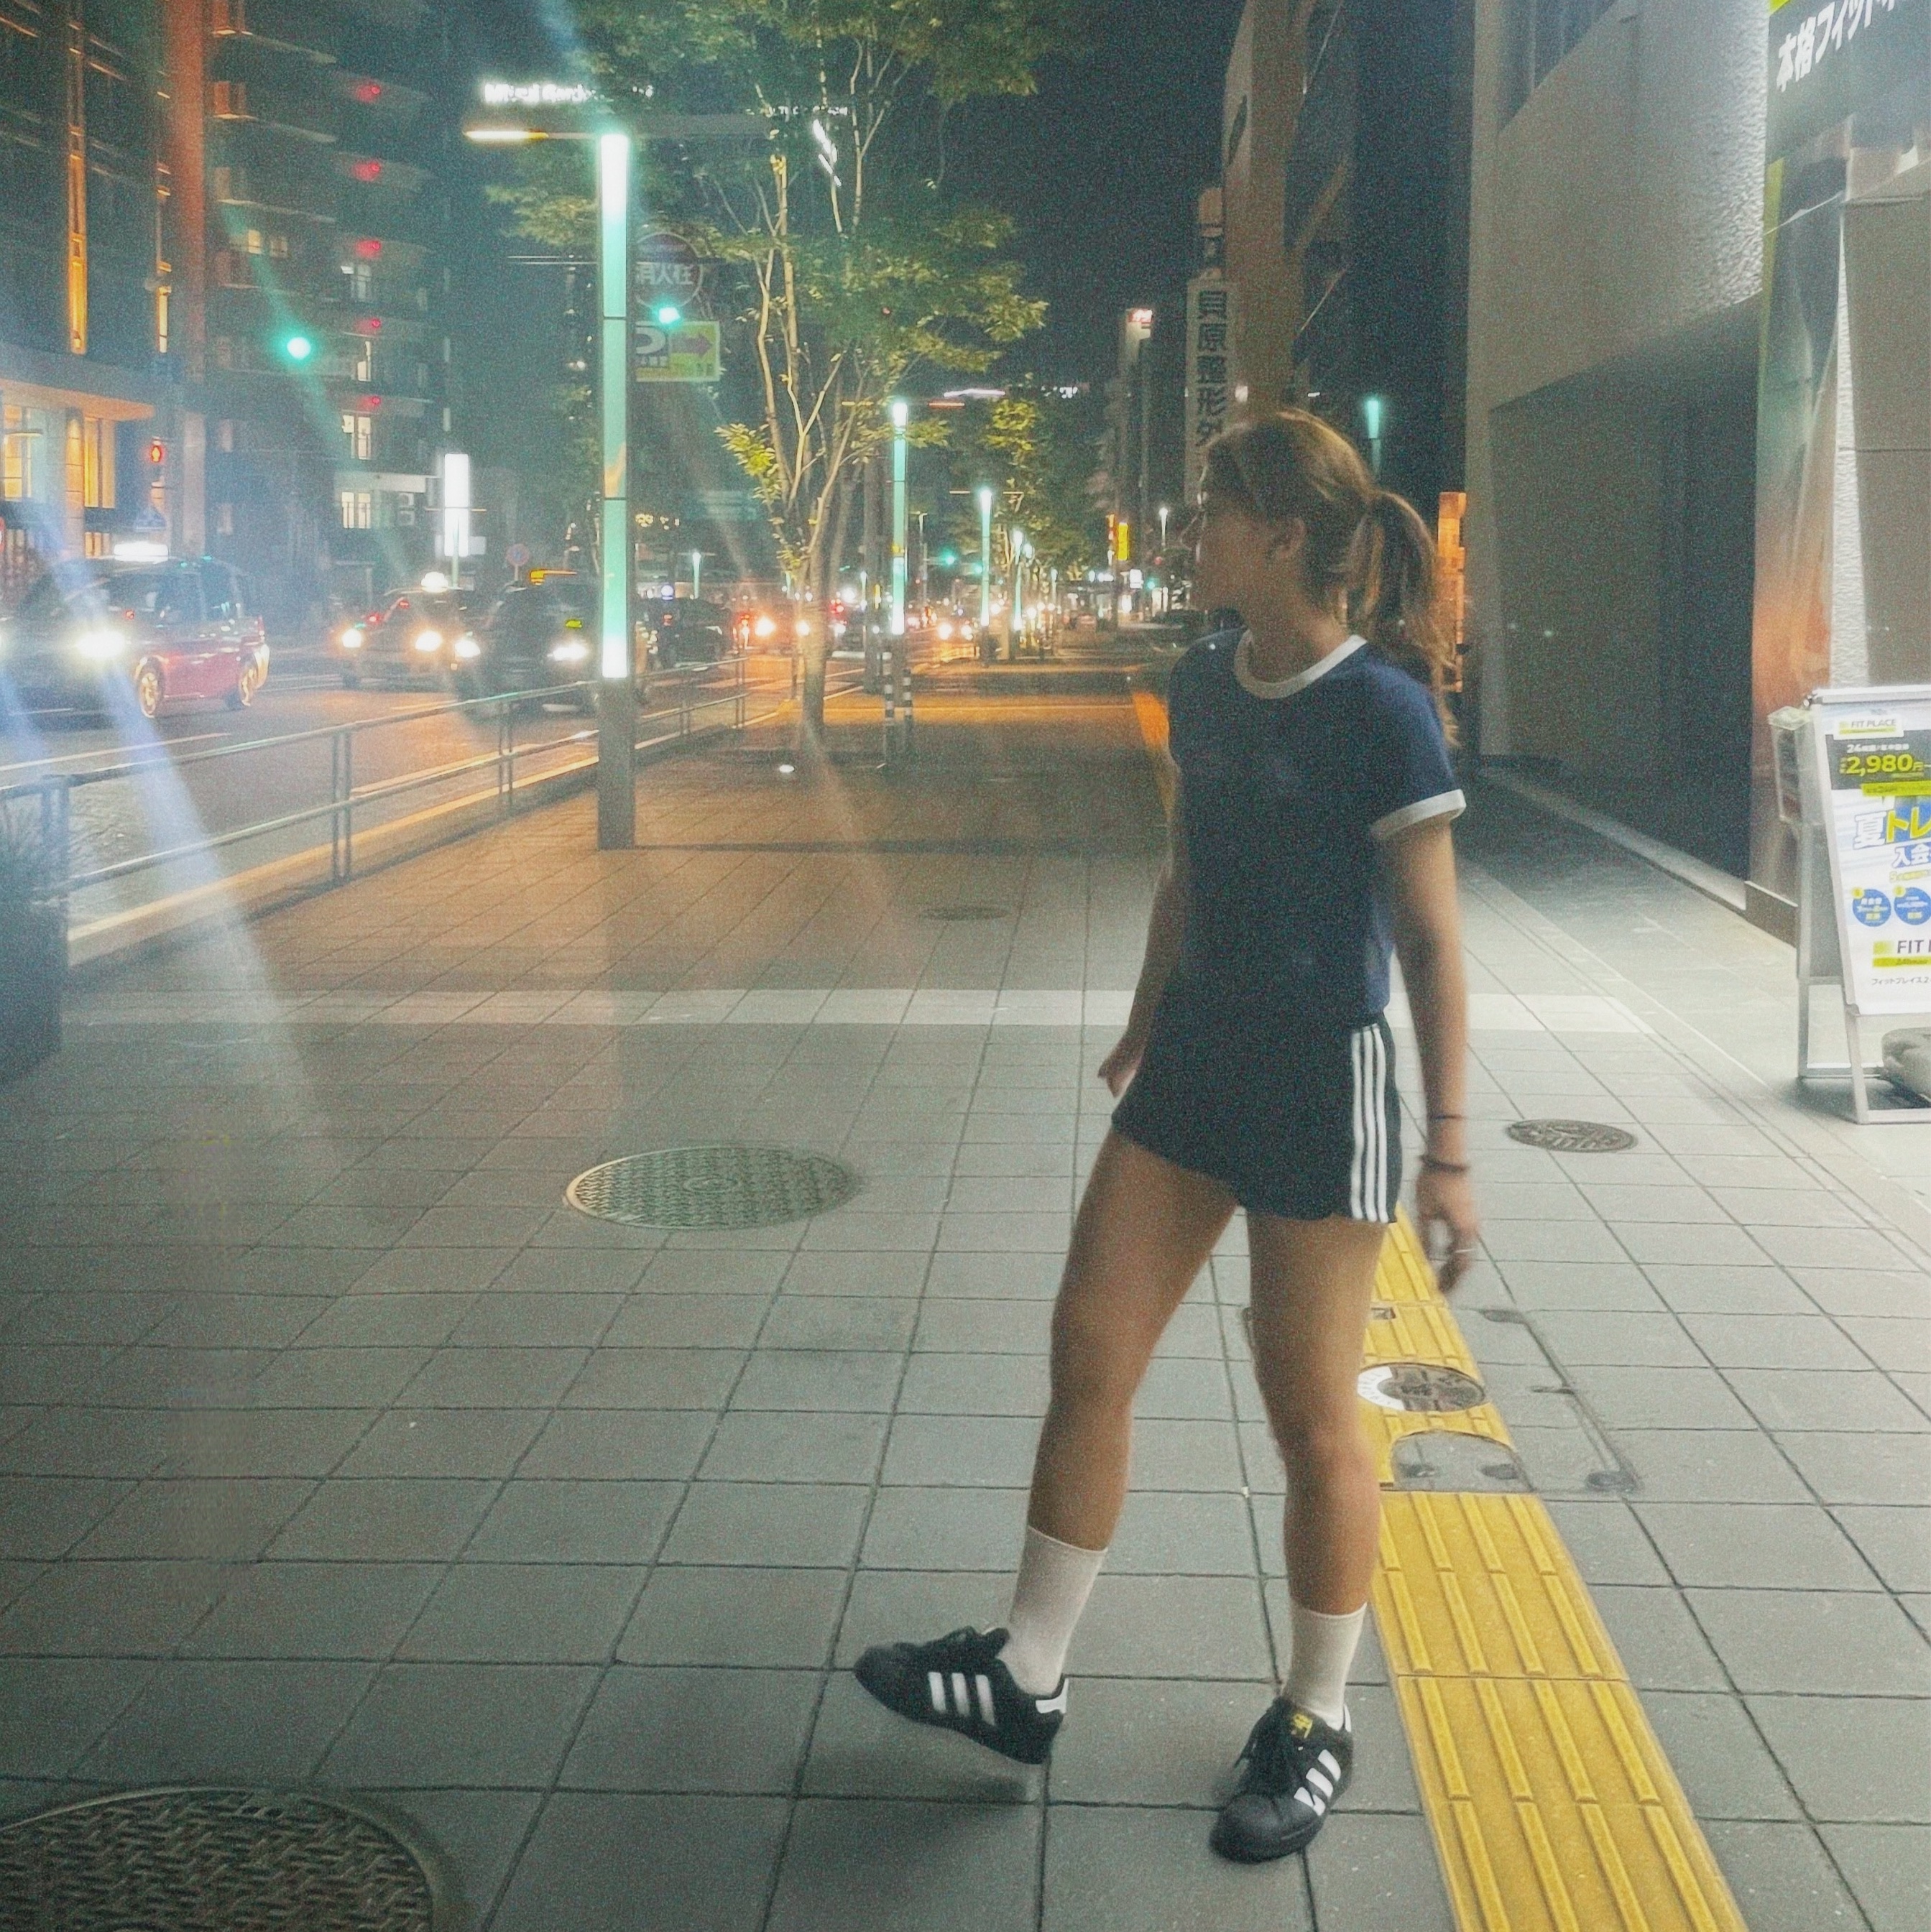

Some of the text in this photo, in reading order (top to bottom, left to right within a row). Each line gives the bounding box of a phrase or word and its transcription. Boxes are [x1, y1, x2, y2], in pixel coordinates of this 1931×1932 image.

[1776, 0, 1895, 93] 本格フィット
[1851, 718, 1897, 729] FIT PLACE
[1891, 843, 1931, 869] 入会
[1897, 938, 1925, 954] FIT
[1871, 976, 1931, 986] フィットプレイス2
